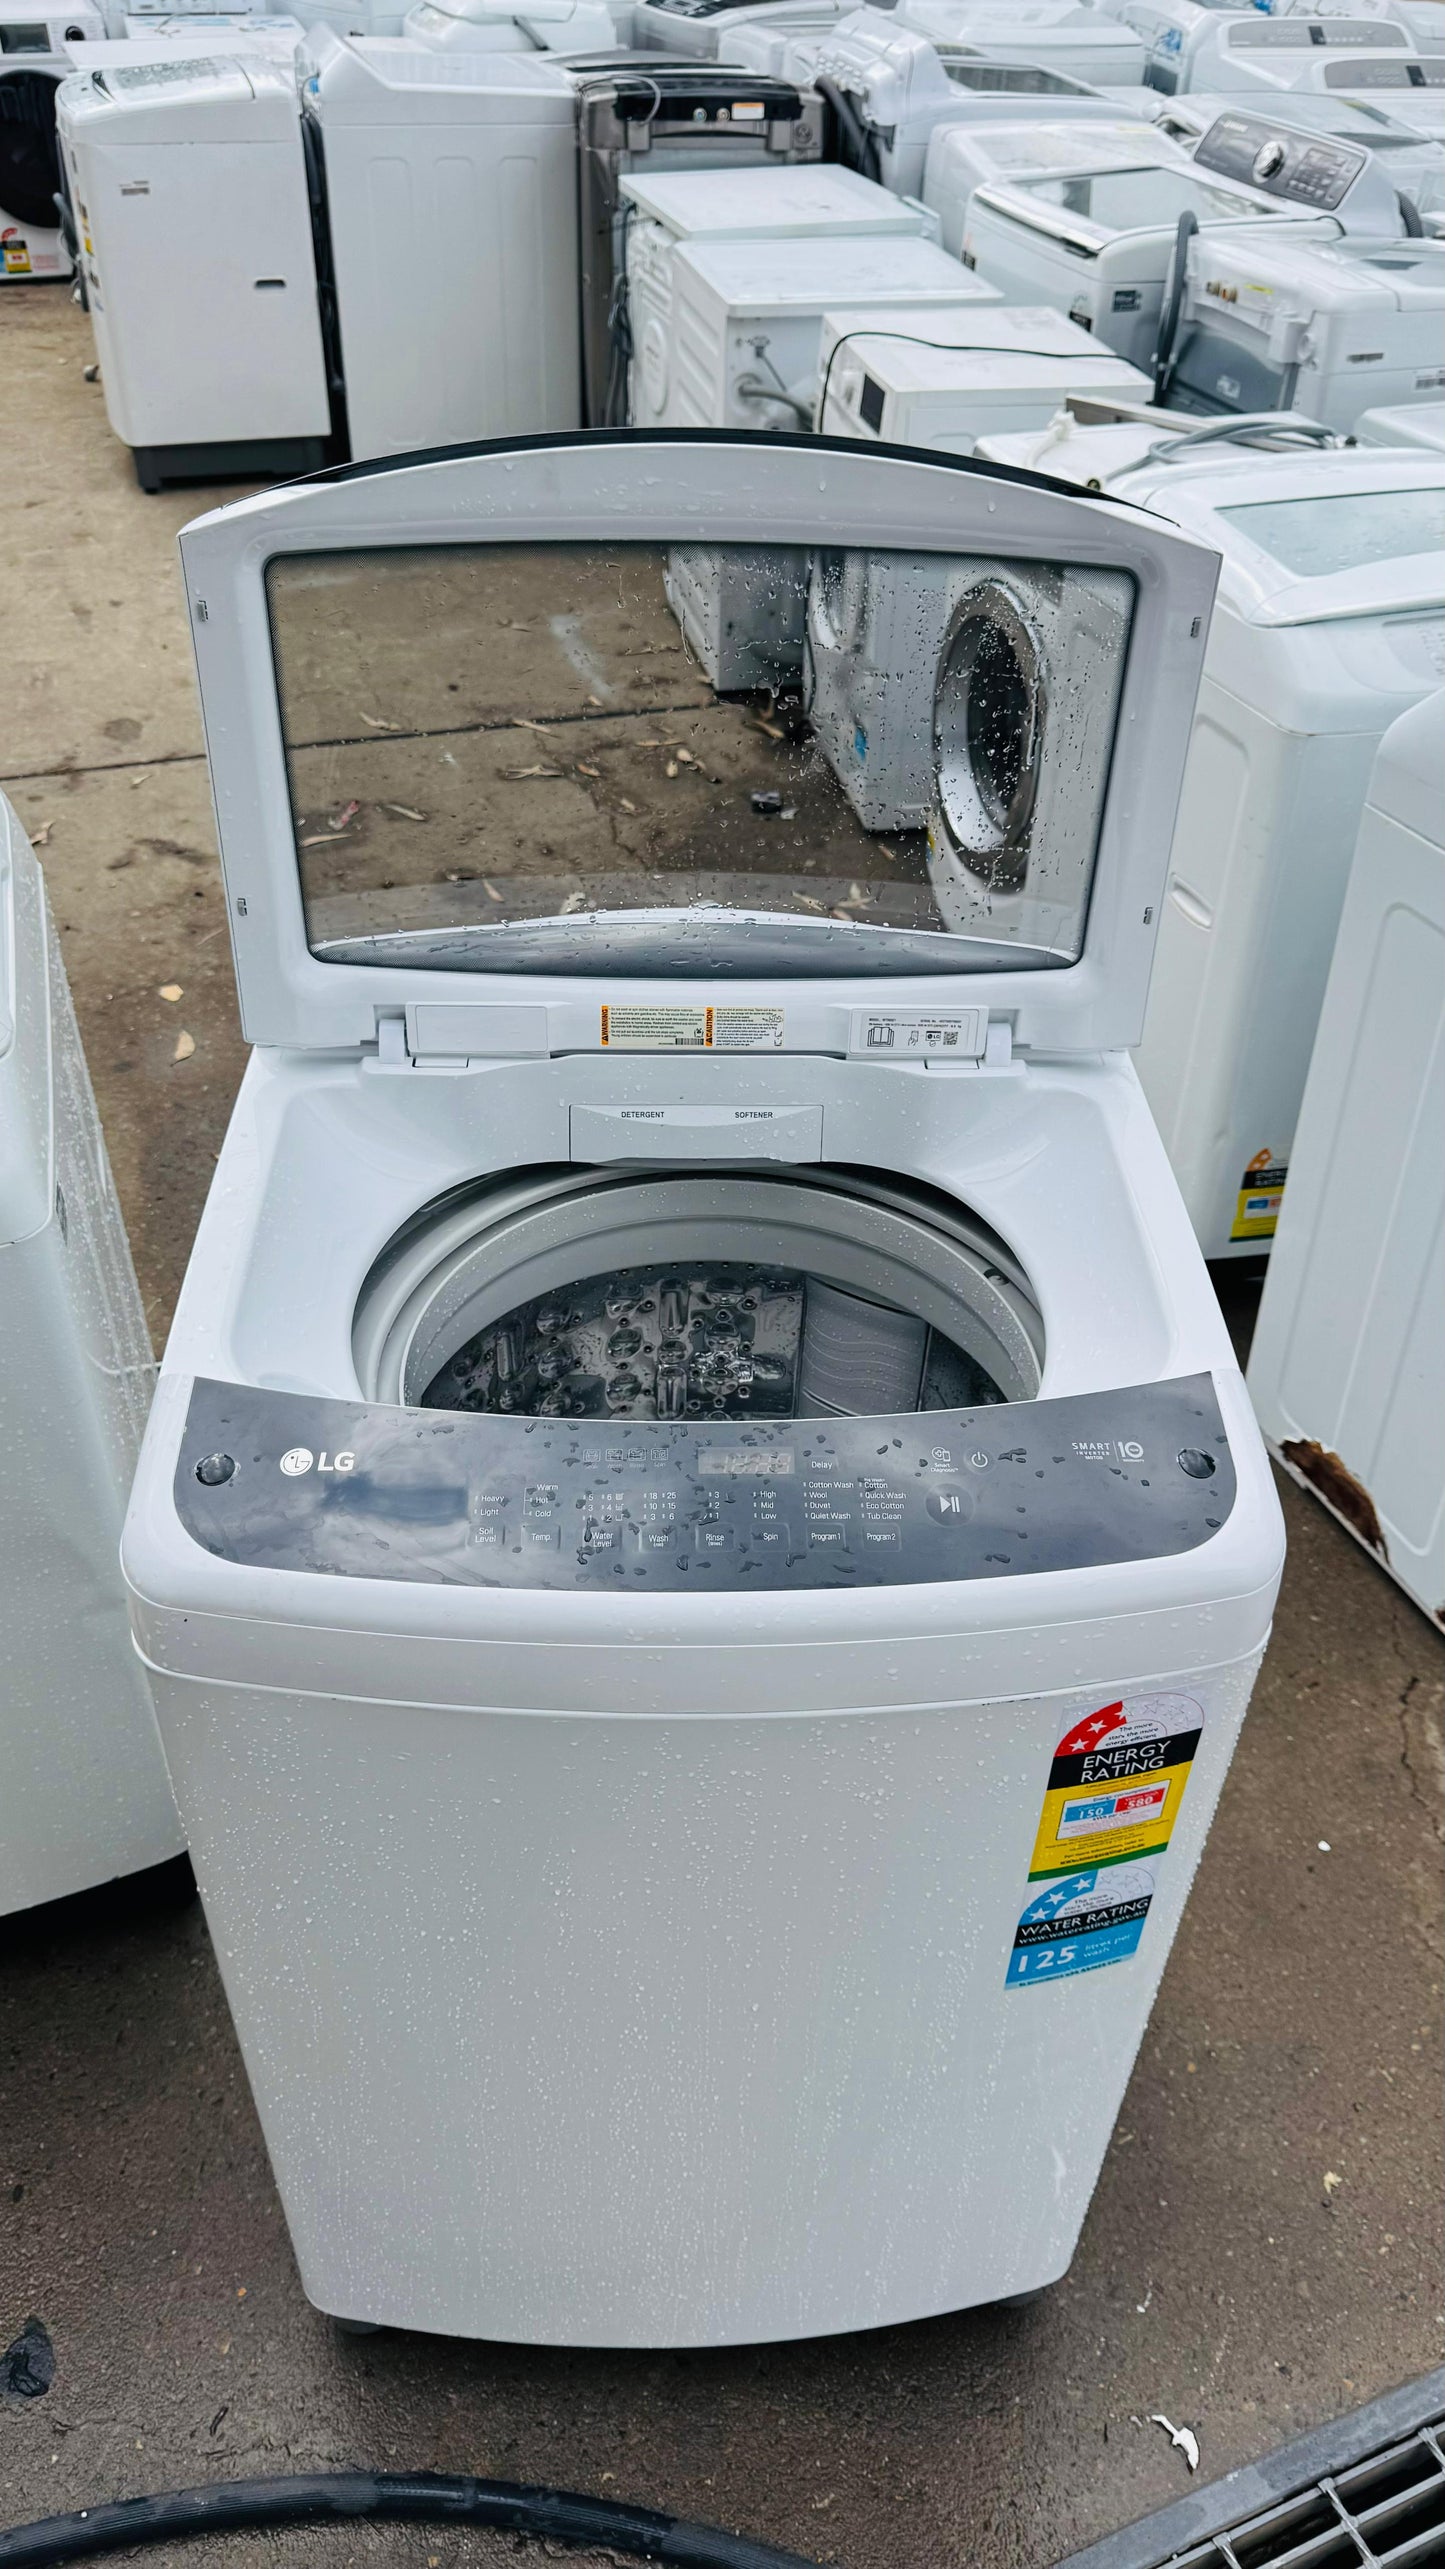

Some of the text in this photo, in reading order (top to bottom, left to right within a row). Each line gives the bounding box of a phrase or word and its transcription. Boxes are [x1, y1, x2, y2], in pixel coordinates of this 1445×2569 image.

[735, 1111, 773, 1119] SOFTENER
[1071, 1442, 1110, 1450] SMART
[317, 1451, 355, 1472] LG
[812, 1461, 832, 1470] Delay
[649, 1492, 658, 1500] 18
[760, 1491, 776, 1499] High
[536, 1496, 549, 1504] Hot
[649, 1502, 658, 1510] 10
[667, 1502, 676, 1510] 15
[480, 1508, 499, 1516] Light
[867, 1512, 902, 1520] Tub Clean
[479, 1527, 494, 1535] Soil
[475, 1535, 496, 1543] Level
[532, 1533, 552, 1542] Temp.
[648, 1534, 669, 1542] Wash
[705, 1533, 725, 1541] Rinse
[763, 1532, 778, 1541] Spin
[811, 1533, 837, 1542] Program
[867, 1533, 891, 1542] Program
[1105, 1734, 1157, 1747] energy efficient
[1083, 1740, 1172, 1769] ENERGY
[1080, 1756, 1165, 1783] RATING
[1126, 1796, 1154, 1809] 580
[1079, 1808, 1104, 1819] 150
[1021, 1898, 1149, 1936] WATER RATING
[1018, 1910, 1146, 1944] www.waterrating.gov.au
[1085, 1935, 1130, 1951] litres per
[1083, 1947, 1110, 1958] wash
[1018, 1946, 1078, 1973] 125
